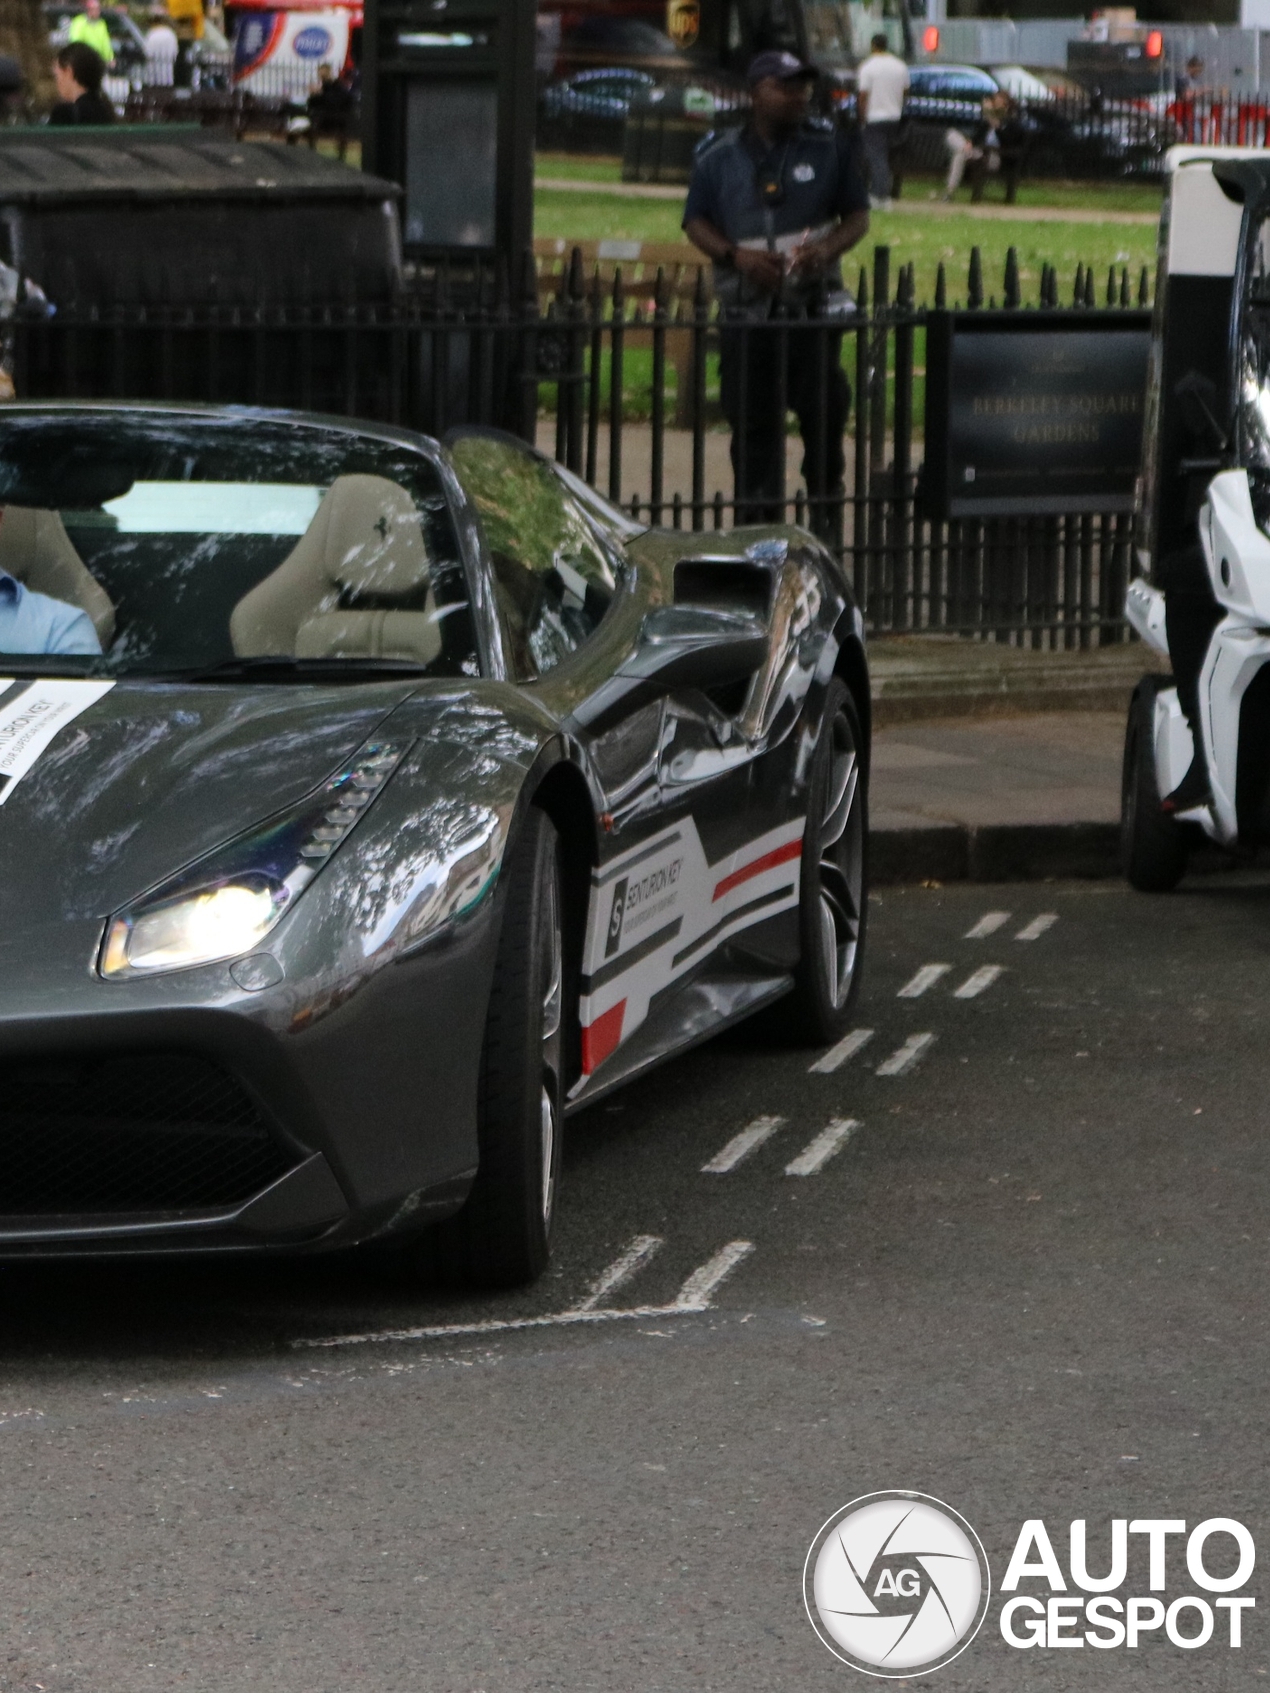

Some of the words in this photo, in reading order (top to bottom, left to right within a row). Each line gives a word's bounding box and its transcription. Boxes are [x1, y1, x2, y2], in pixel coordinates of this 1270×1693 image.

[973, 396, 1064, 415] BERKELEY
[1013, 423, 1100, 443] GARDENS
[27, 698, 55, 718] KEY
[0, 752, 17, 769] YOUR
